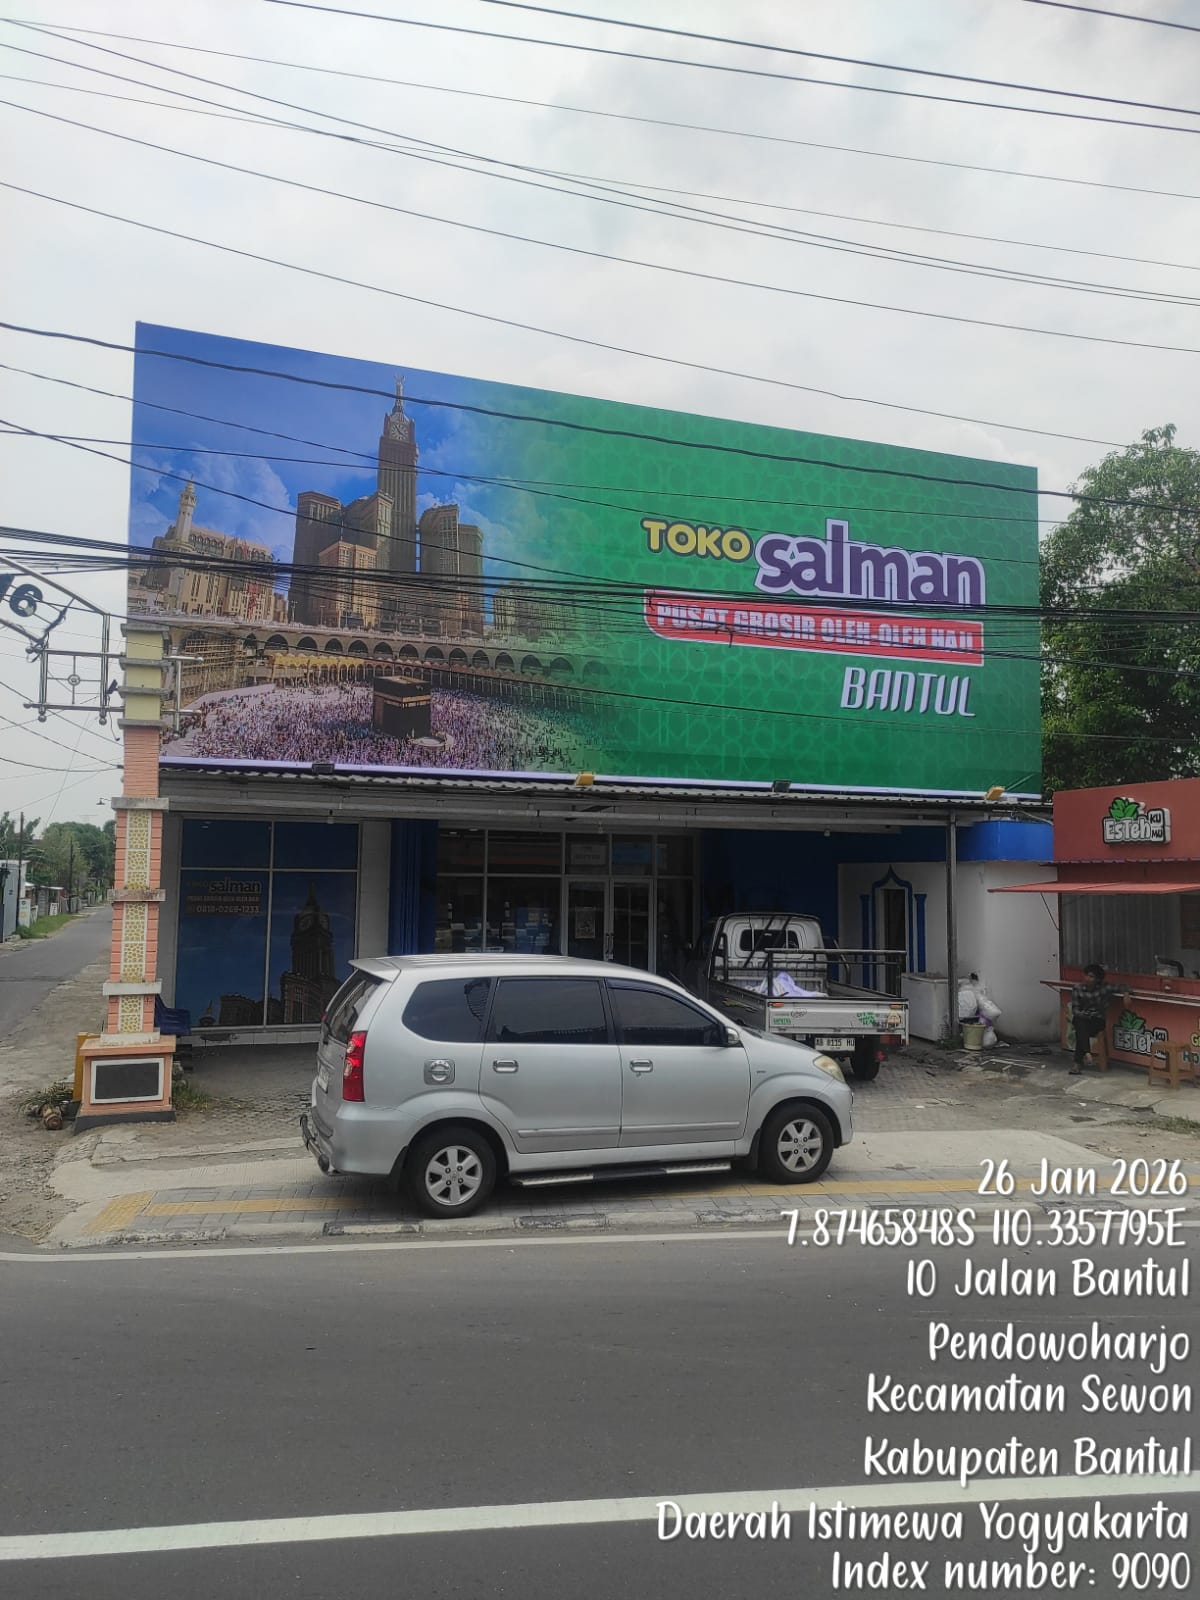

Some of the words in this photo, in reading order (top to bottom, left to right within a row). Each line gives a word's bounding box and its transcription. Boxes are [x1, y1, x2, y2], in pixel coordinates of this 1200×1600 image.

[641, 518, 753, 562] TOKO
[755, 518, 985, 608] salman
[657, 601, 729, 632] PUSAT
[733, 610, 816, 641] GROSIR
[821, 616, 927, 649] OLEH-OLEH
[840, 666, 976, 718] BANTUL
[1150, 813, 1161, 824] KU
[1151, 829, 1163, 839] MU
